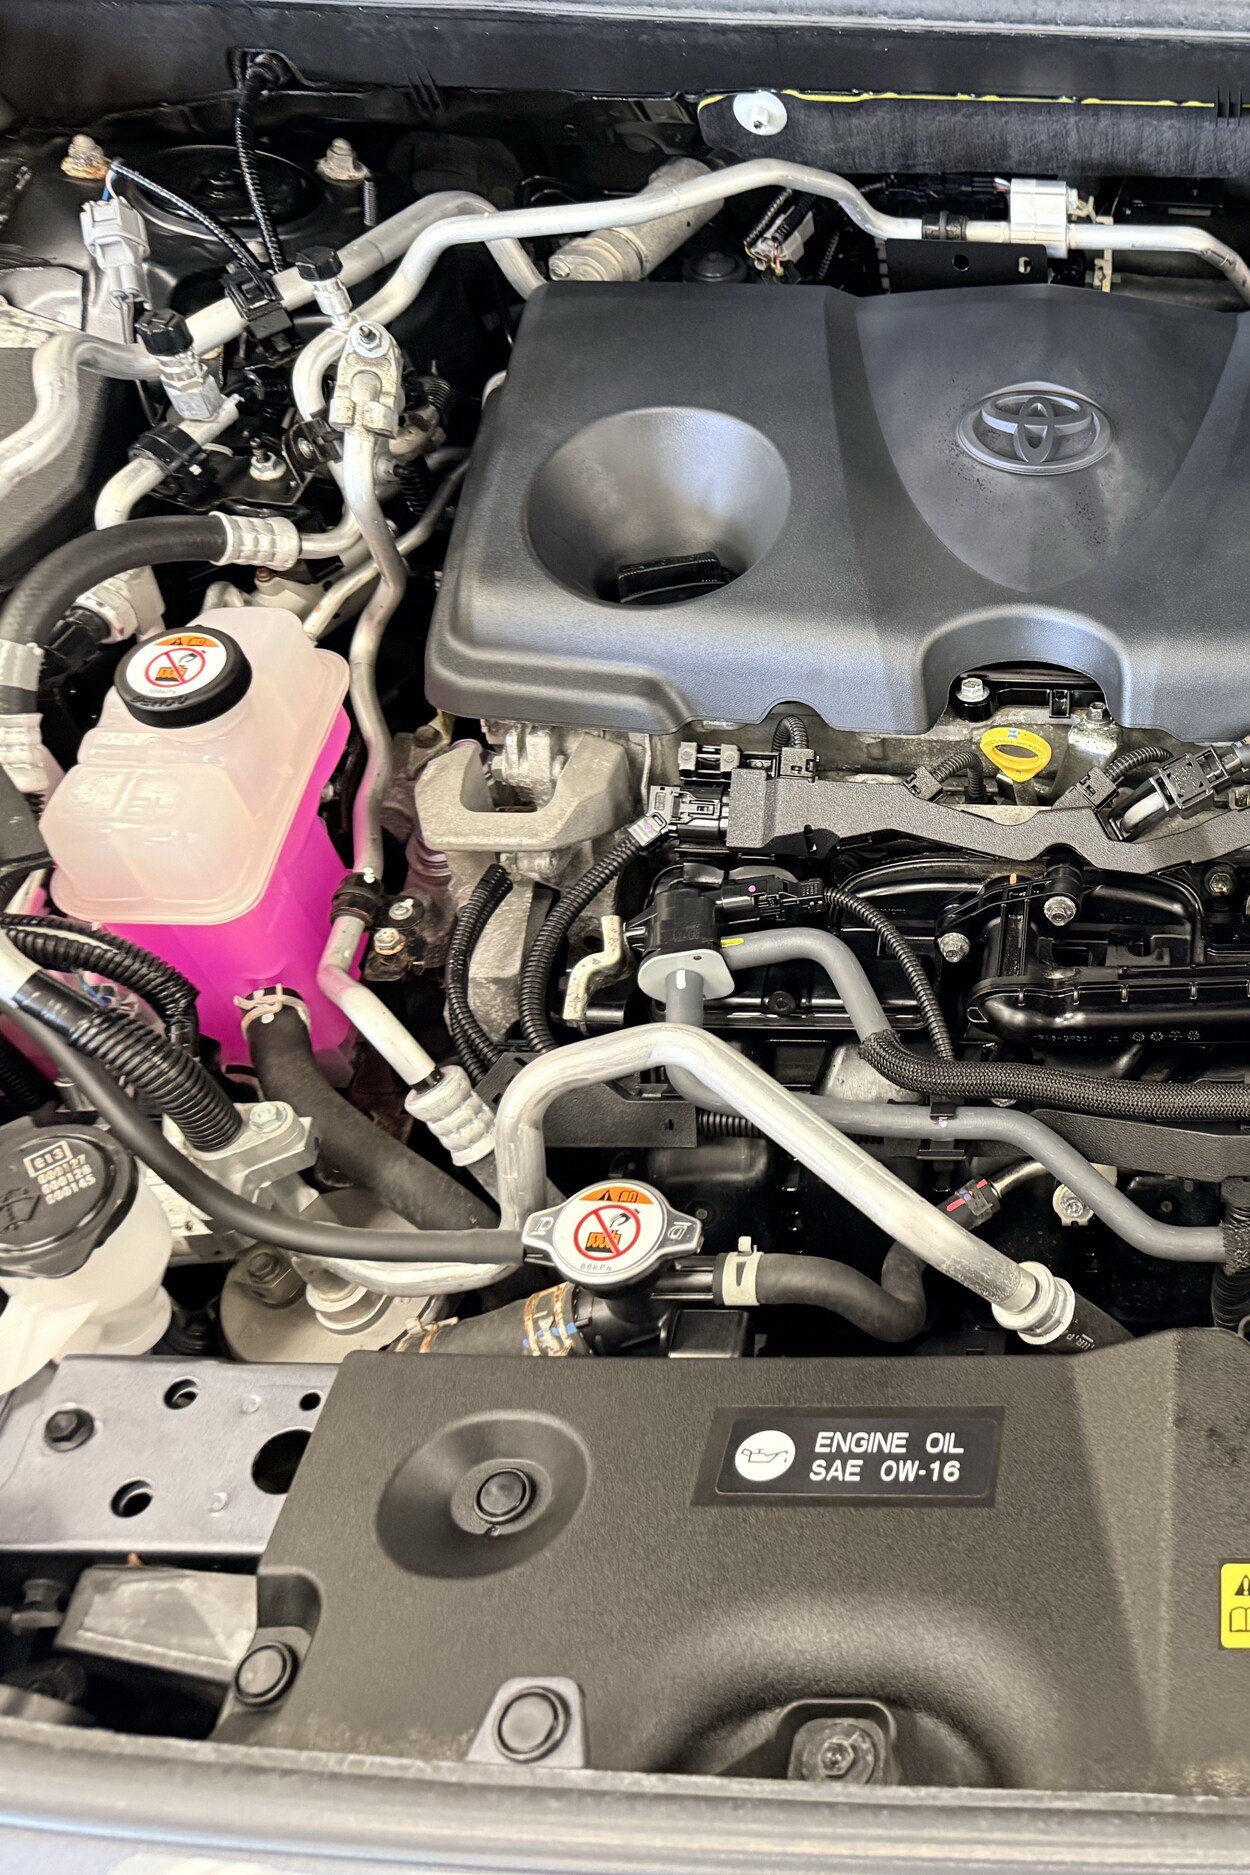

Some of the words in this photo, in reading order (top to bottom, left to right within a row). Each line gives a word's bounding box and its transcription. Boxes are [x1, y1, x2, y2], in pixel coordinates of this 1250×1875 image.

[33, 1148, 65, 1169] e13
[814, 1431, 910, 1454] ENGINE
[925, 1432, 965, 1454] OIL
[809, 1459, 864, 1482] SAE
[880, 1460, 961, 1482] 0W-16
